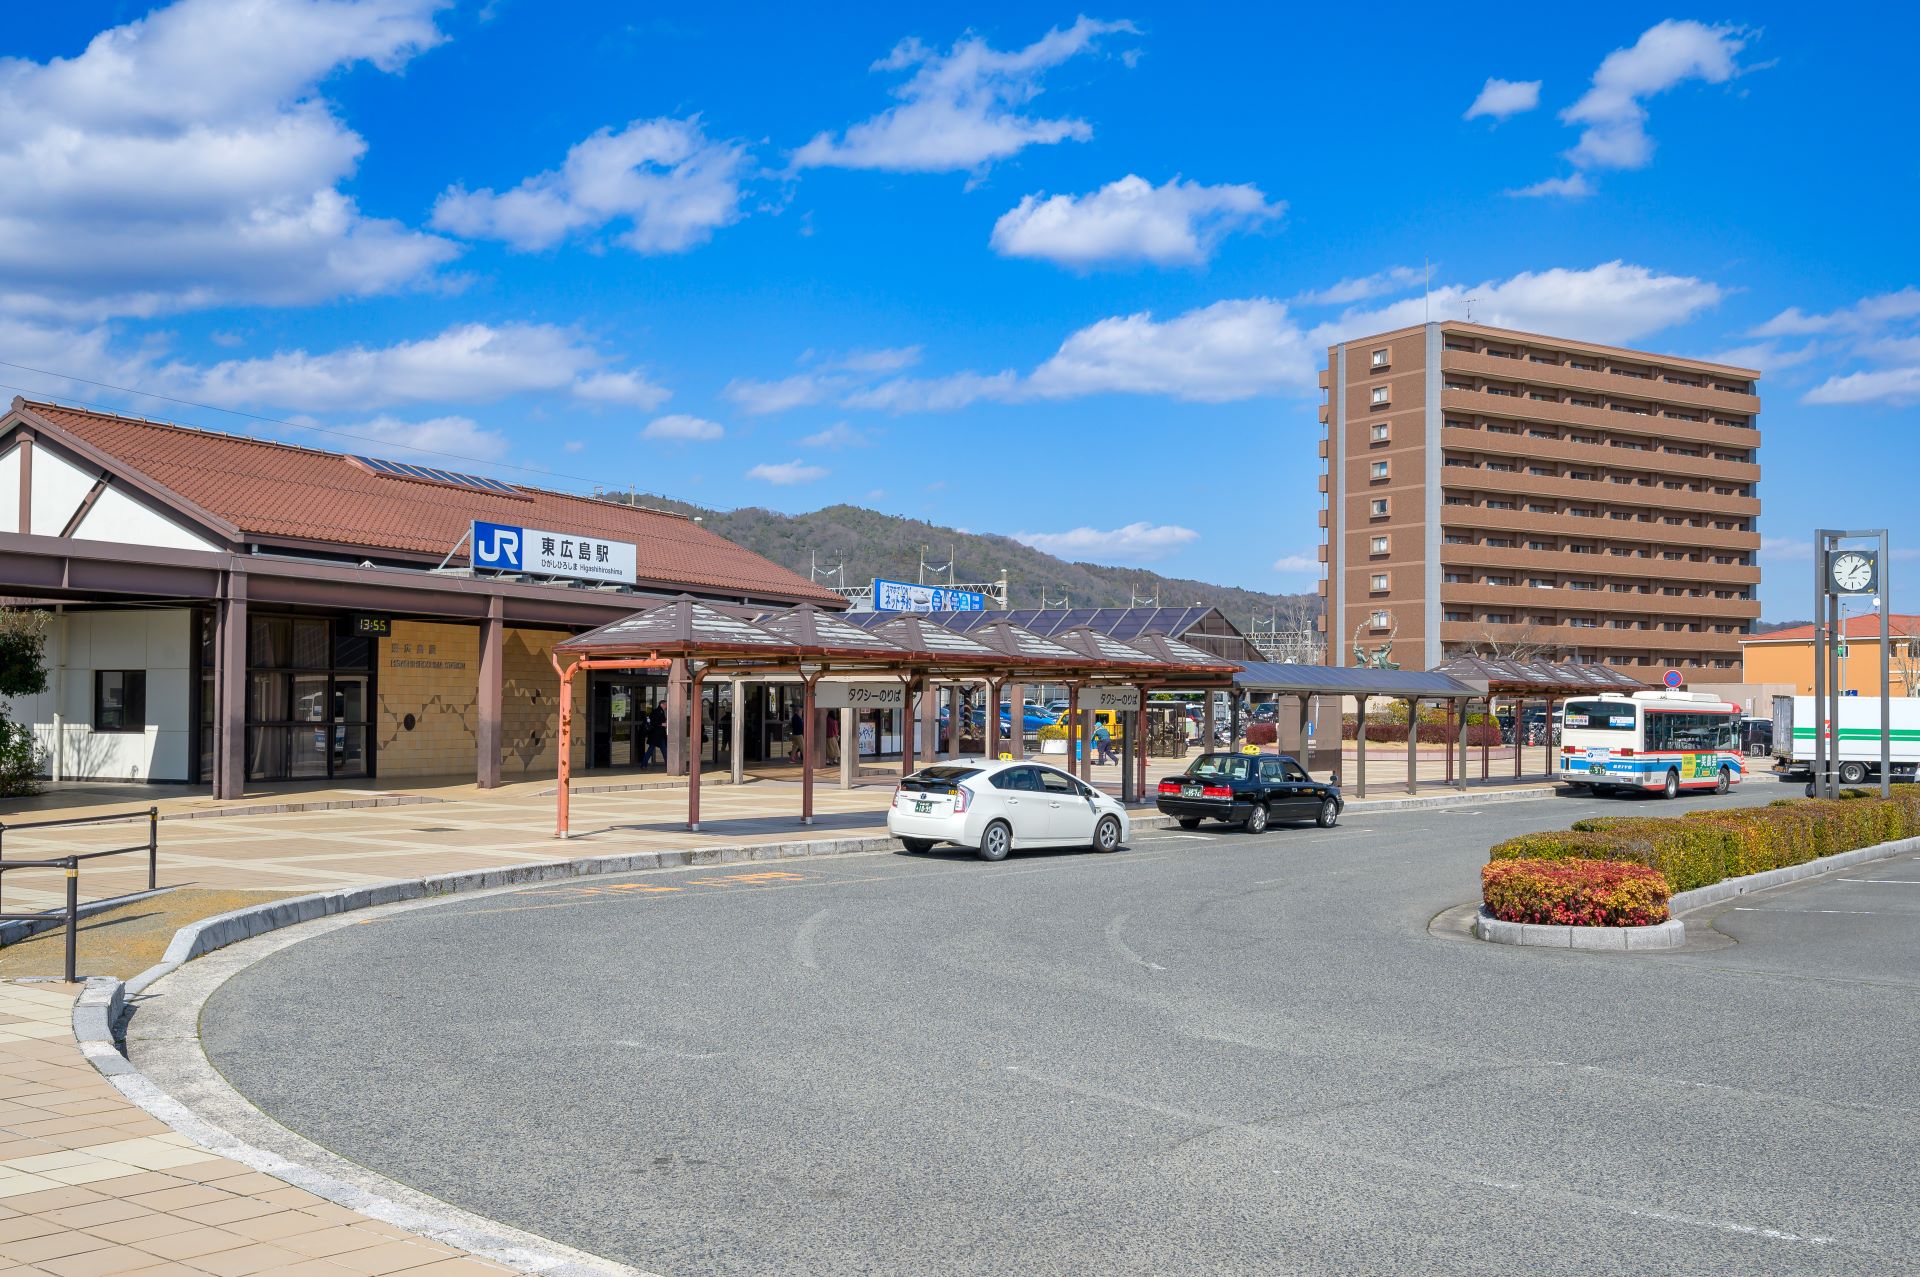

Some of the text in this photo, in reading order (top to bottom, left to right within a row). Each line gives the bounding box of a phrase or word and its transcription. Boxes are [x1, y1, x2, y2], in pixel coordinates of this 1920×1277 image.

[478, 529, 519, 565] JR
[541, 536, 609, 563] 東広島駅
[541, 559, 623, 576] ひがしひろしま Higashihiroshima
[359, 619, 386, 632] 13:55
[848, 688, 902, 703] タクシーのりば
[1100, 693, 1138, 706] タクシーのりば
